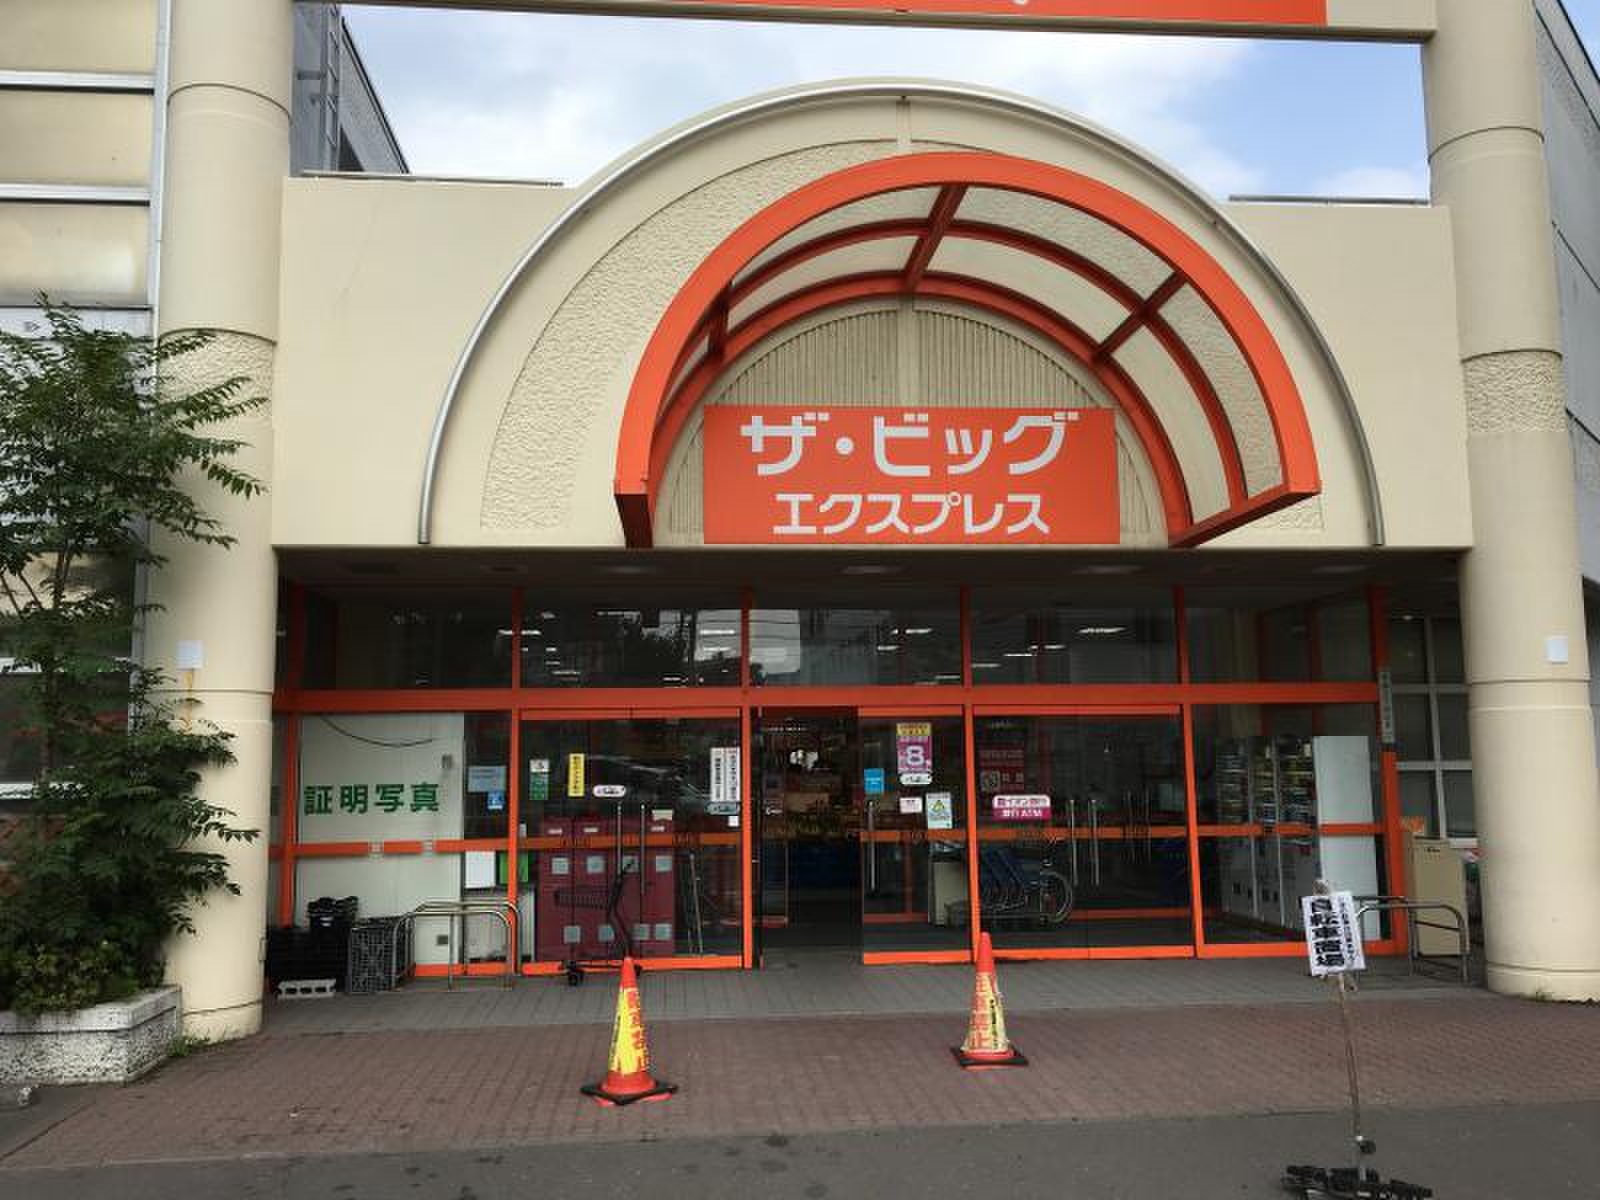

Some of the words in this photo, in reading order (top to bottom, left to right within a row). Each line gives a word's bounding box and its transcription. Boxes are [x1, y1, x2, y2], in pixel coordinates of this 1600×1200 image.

[740, 412, 1080, 478] ザ・ビッグ
[773, 492, 1051, 535] エクスプレス
[304, 781, 440, 814] 証明写真
